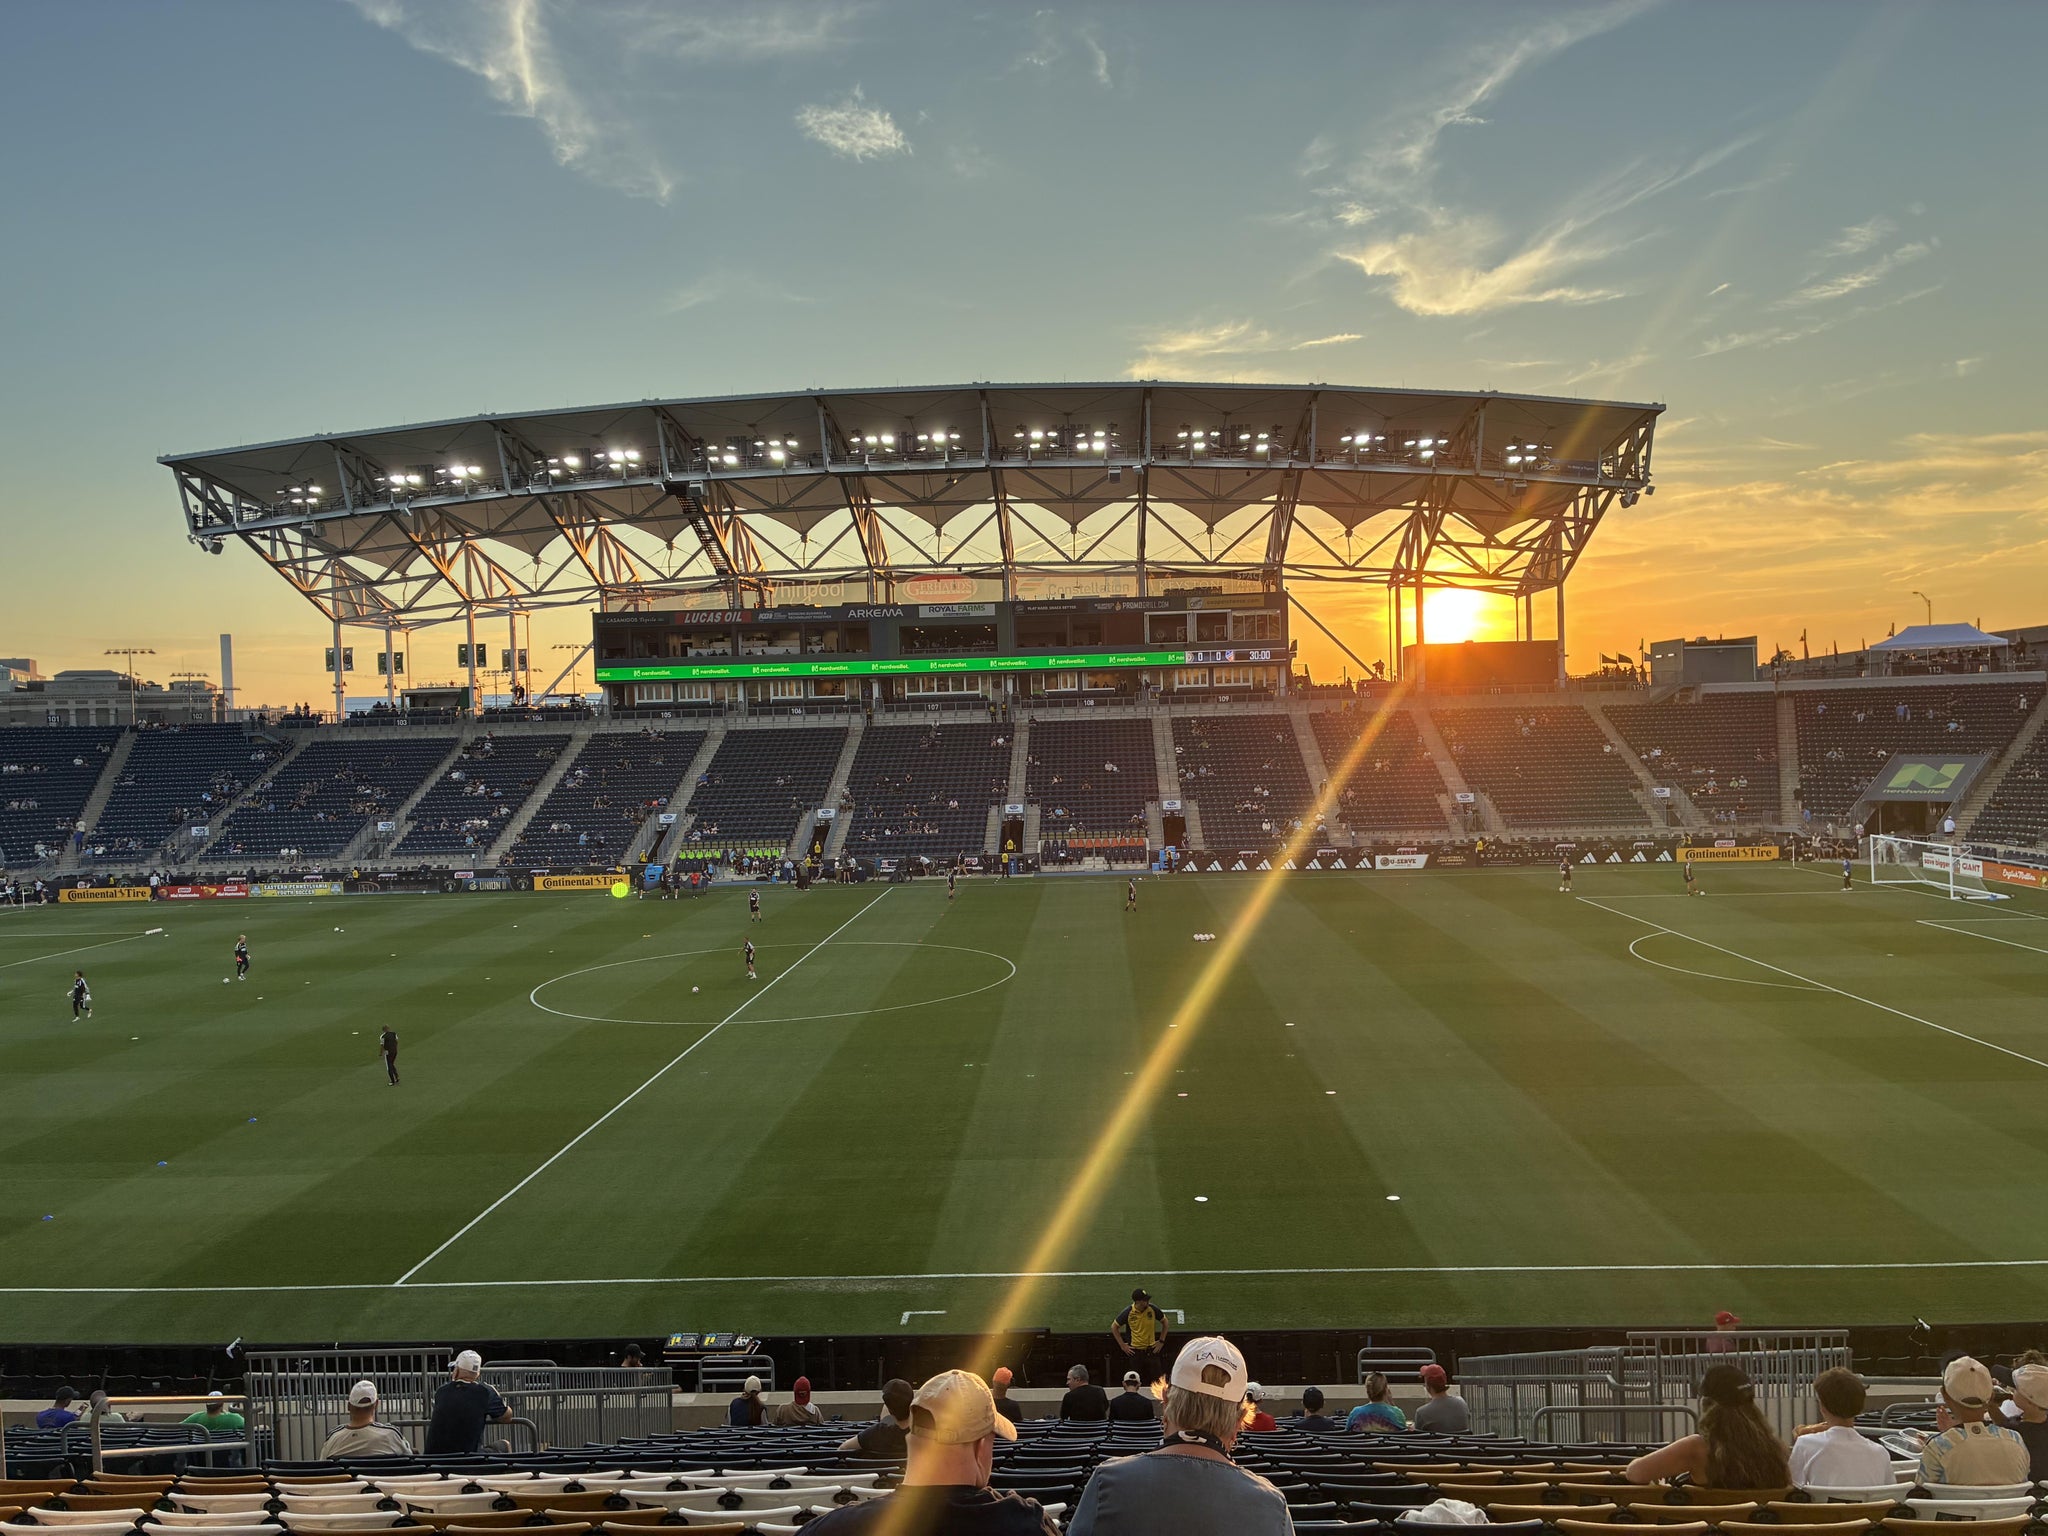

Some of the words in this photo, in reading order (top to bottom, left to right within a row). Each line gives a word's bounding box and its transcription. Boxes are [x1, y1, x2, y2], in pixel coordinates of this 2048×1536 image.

[772, 580, 845, 602] hirlpool
[1047, 582, 1130, 596] Constellation
[848, 608, 904, 618] ARKEMA
[928, 605, 956, 613] ROYAL
[957, 604, 986, 612] FARMS
[684, 612, 722, 624] LUCAS
[724, 611, 742, 623] OIL
[1198, 652, 1203, 662] 0
[1216, 651, 1221, 661] 0
[1249, 650, 1271, 661] 30:00
[1685, 848, 1740, 860] Continental
[1750, 847, 1772, 858] Tire
[1962, 862, 1981, 872] GIANT
[479, 881, 500, 891] UNION
[542, 877, 594, 889] Continental
[602, 876, 624, 886] Tire
[67, 888, 117, 901] Continental
[123, 887, 147, 898] Tire
